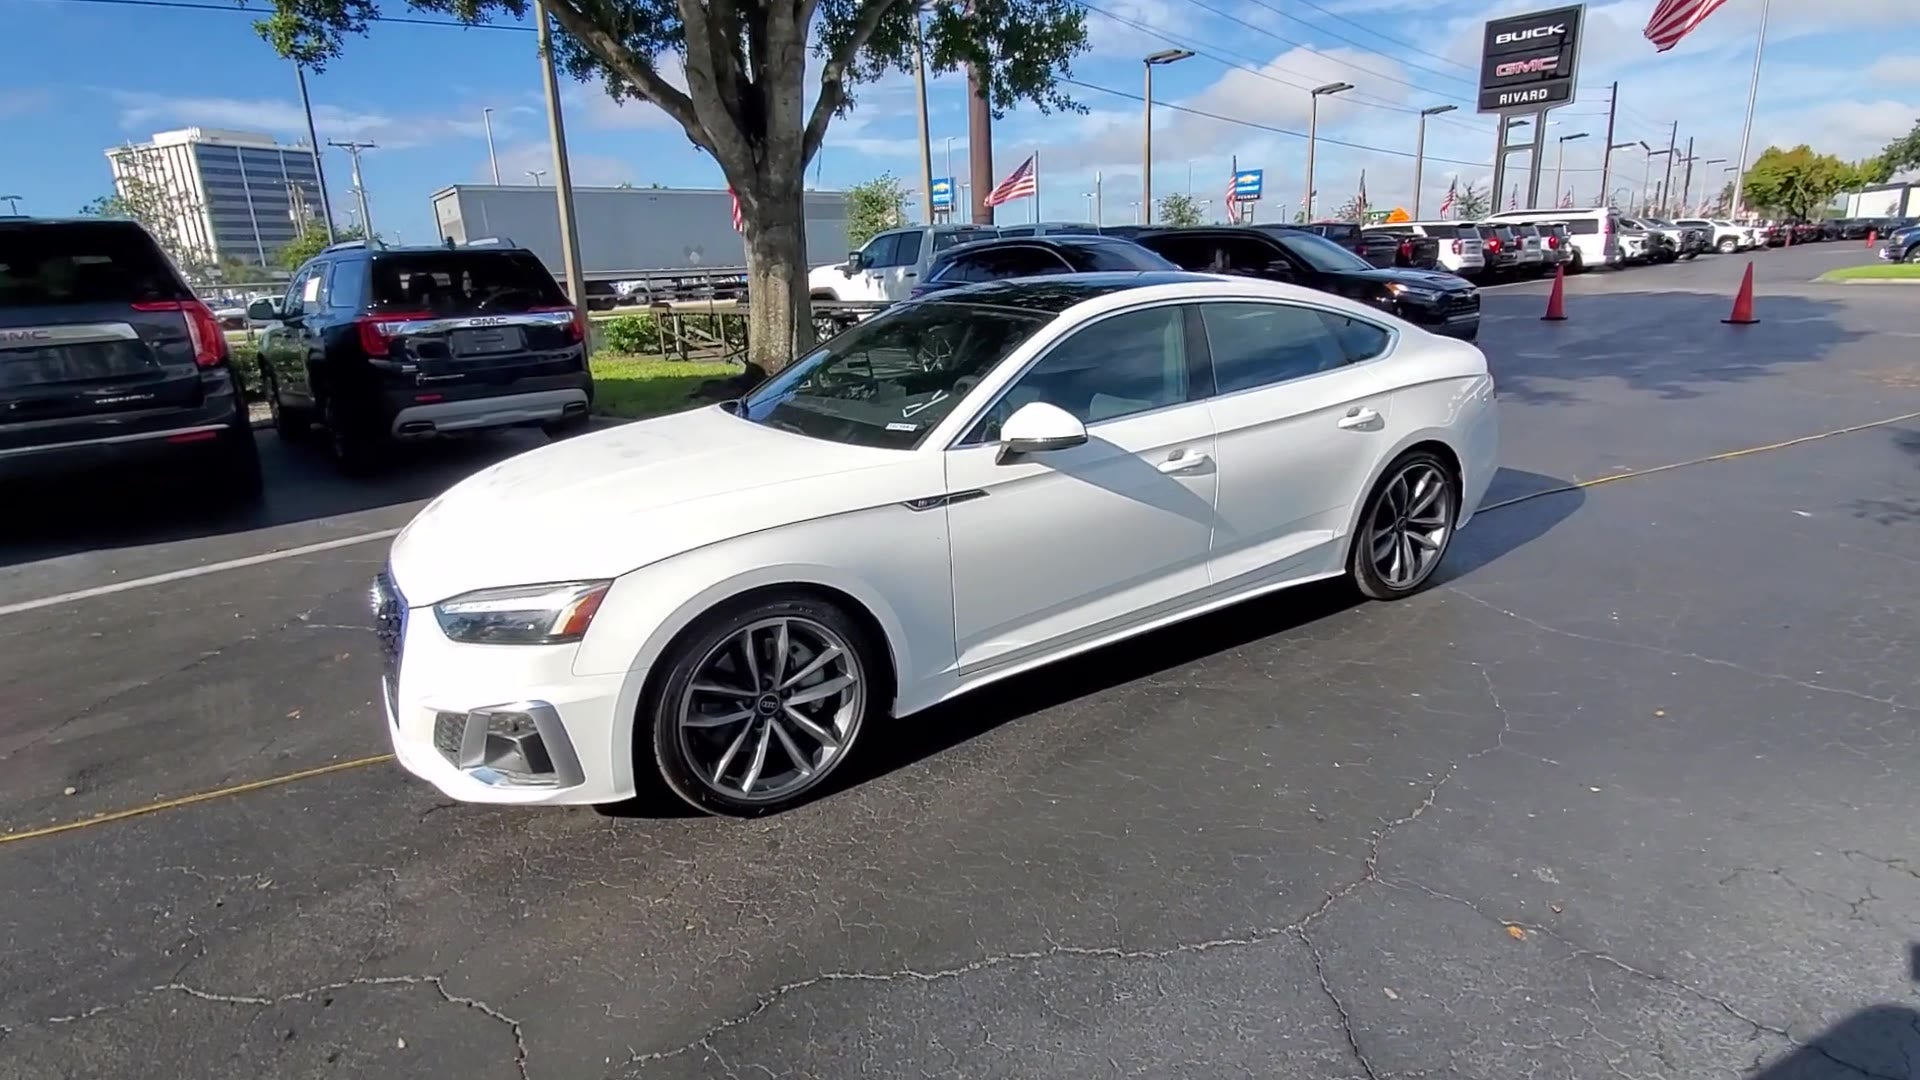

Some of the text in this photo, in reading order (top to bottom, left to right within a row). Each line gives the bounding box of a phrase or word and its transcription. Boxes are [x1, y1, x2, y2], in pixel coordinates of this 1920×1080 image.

[1495, 24, 1566, 44] BUICK
[1495, 55, 1559, 77] GMC
[1499, 88, 1548, 105] RIVARD
[469, 317, 507, 326] GMC
